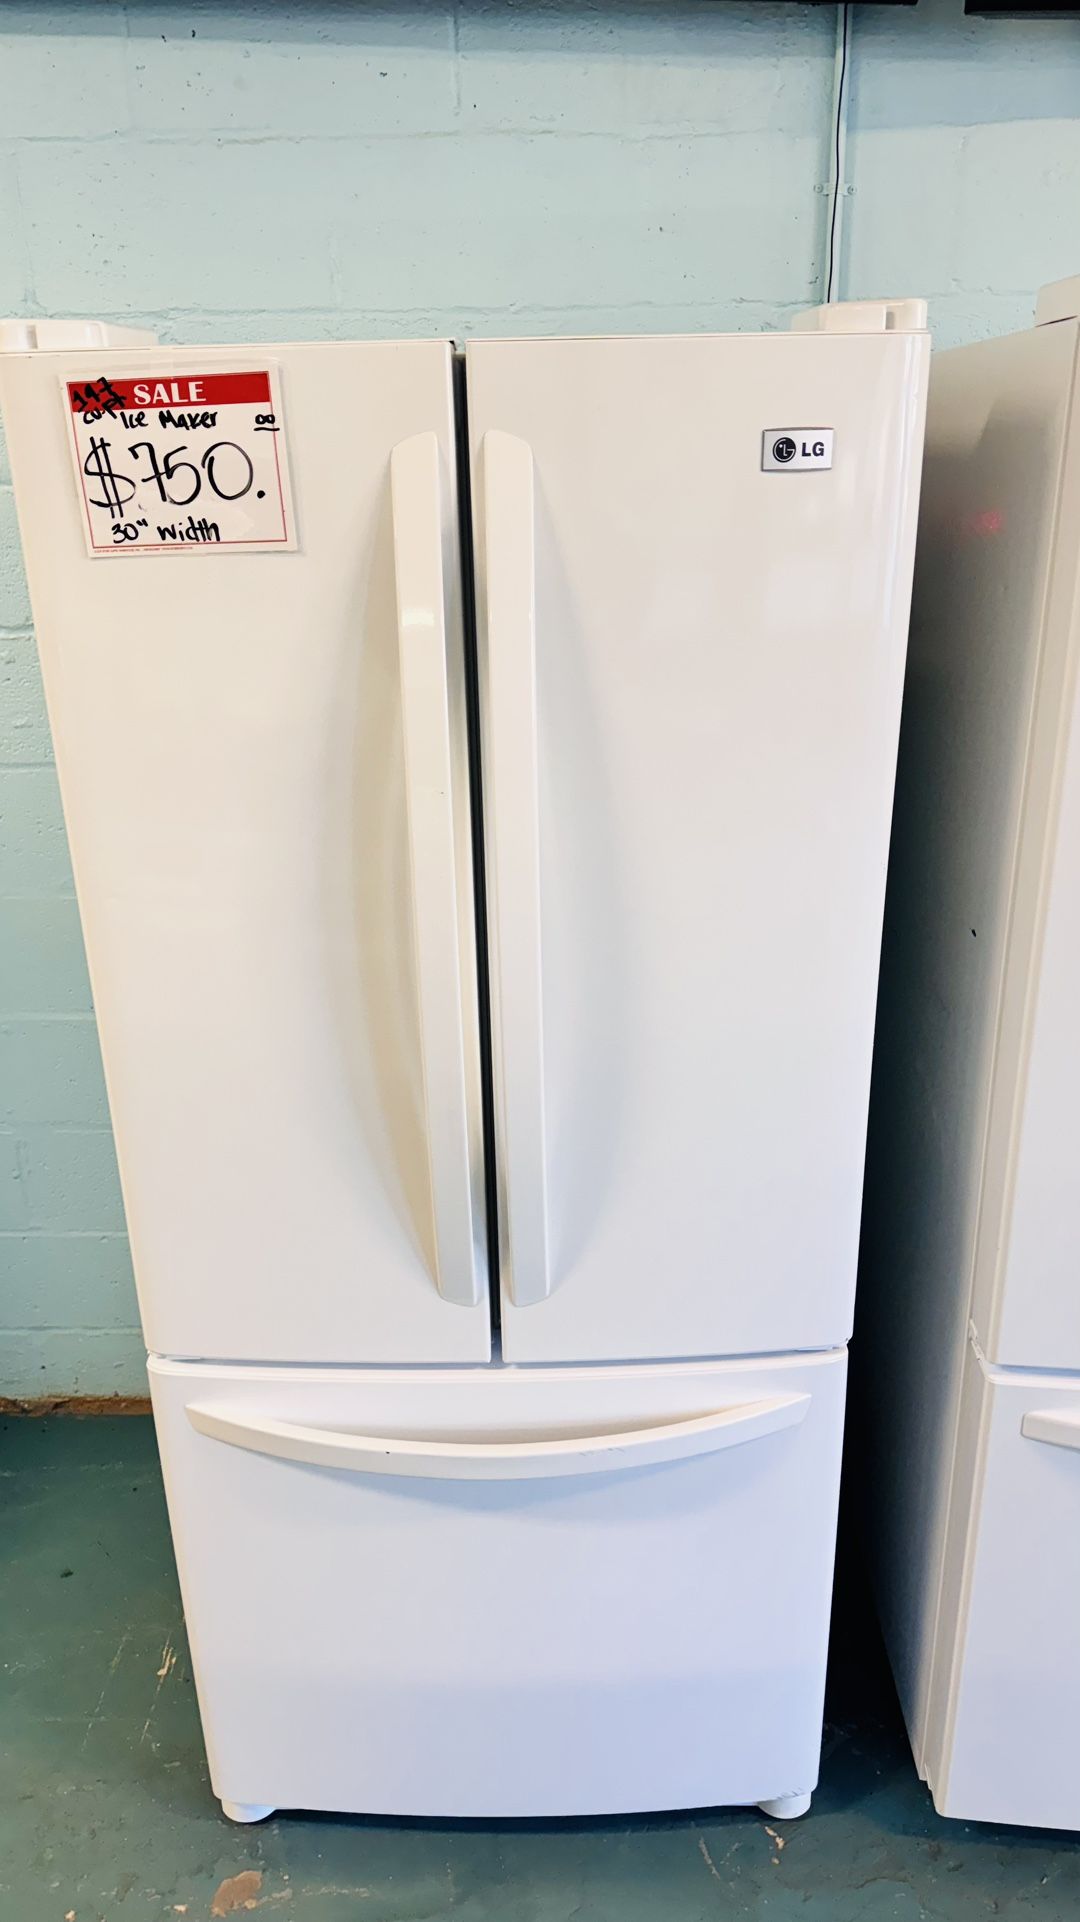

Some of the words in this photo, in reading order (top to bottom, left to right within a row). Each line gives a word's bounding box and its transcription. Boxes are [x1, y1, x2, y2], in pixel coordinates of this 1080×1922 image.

[133, 382, 206, 405] SALE
[120, 411, 149, 429] Ice
[158, 410, 218, 430] Maker
[801, 441, 825, 457] LG
[111, 519, 148, 543] 30"
[157, 516, 220, 541] width
